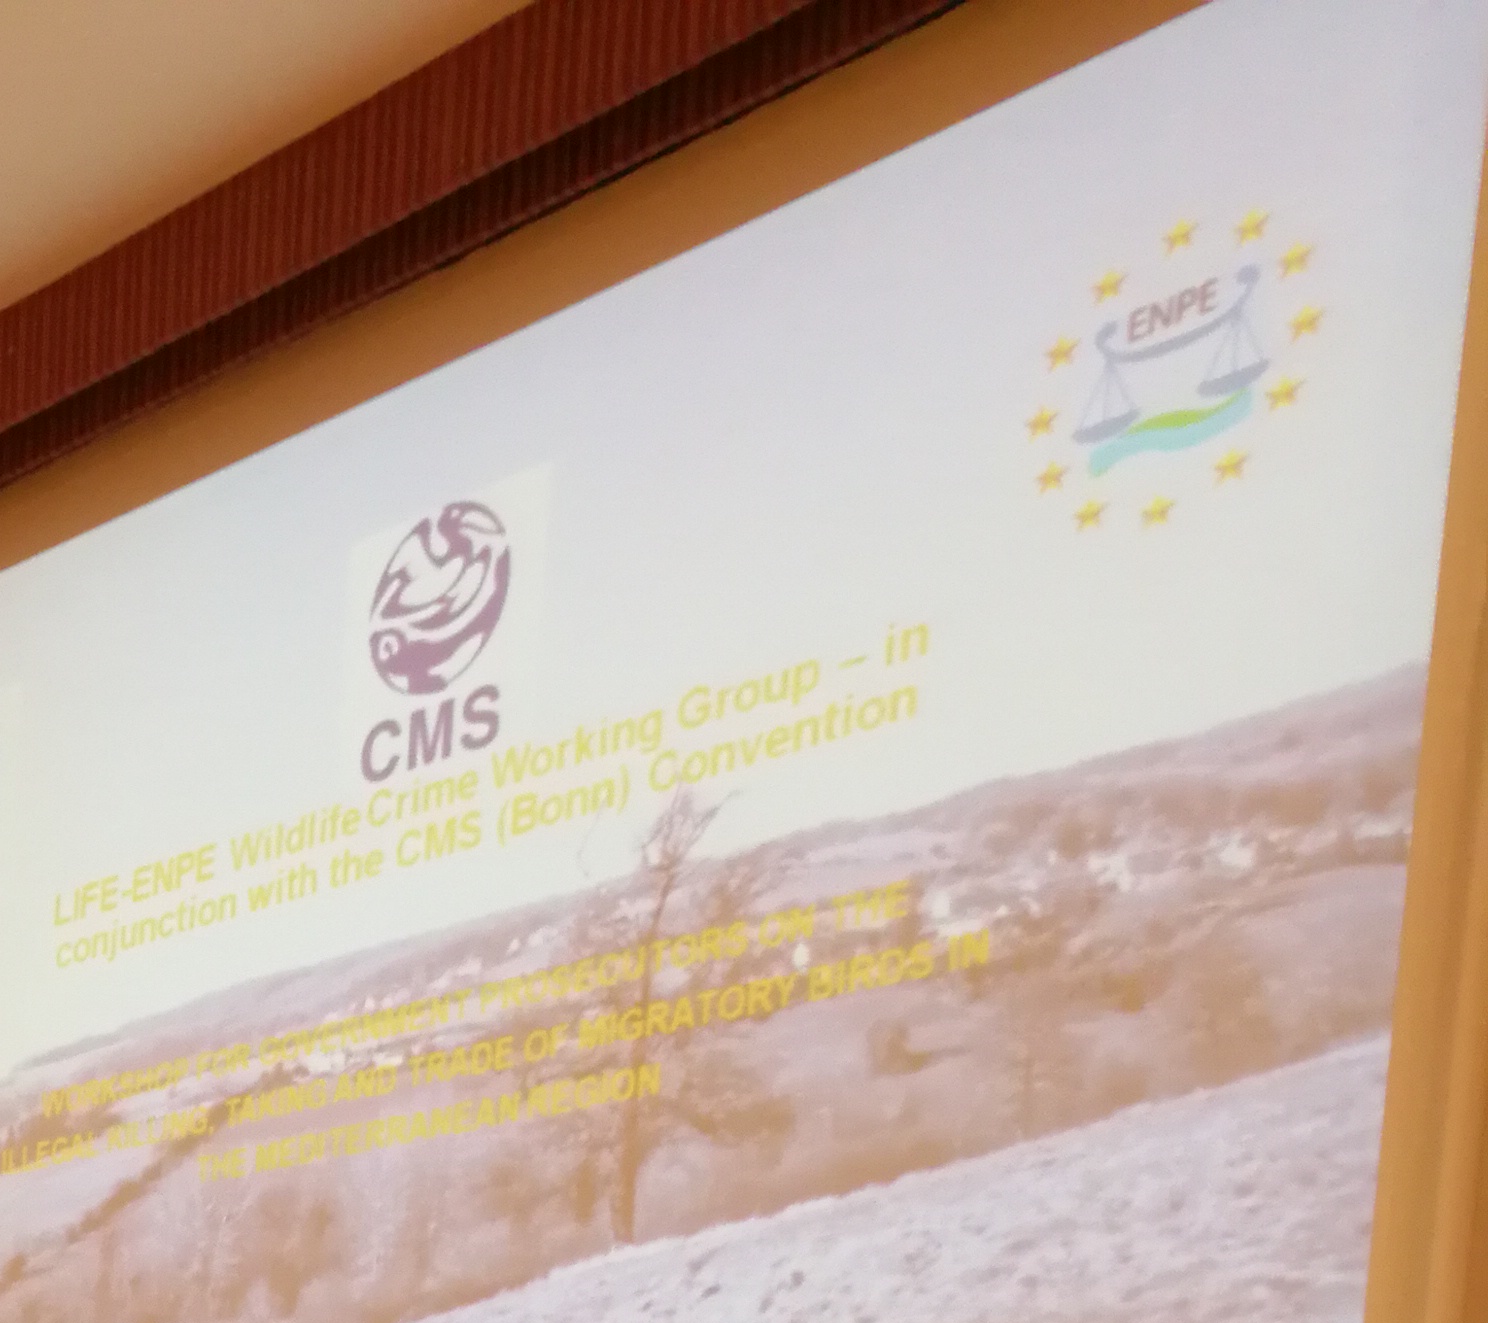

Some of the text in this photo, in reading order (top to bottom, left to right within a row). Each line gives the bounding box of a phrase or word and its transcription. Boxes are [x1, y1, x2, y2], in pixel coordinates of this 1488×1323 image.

[1127, 277, 1218, 343] ENPE
[53, 844, 218, 927] LIFE-ENPE
[231, 804, 361, 873] Wildlife
[367, 768, 479, 829] Crime
[492, 706, 663, 787] Working
[677, 658, 821, 730] Group
[885, 620, 929, 666] in
[55, 684, 918, 968] conjunction with the CMS (Bonn) Convention
[361, 684, 501, 783] CMS
[0, 1129, 96, 1175] ILLEGAL
[223, 1078, 328, 1128] TAKING
[332, 1061, 398, 1104] AND
[408, 1035, 514, 1087] TRADE
[523, 1022, 567, 1060] OF
[578, 971, 798, 1050] MIGRATORY
[805, 939, 935, 1001] BIRDS
[948, 927, 991, 971] IN
[41, 878, 910, 1119] WORKSHOP FOR GOVERNMENT PROSECUTORS ON THE
[199, 1062, 663, 1184] THE MEDITERRANEAN REGION
